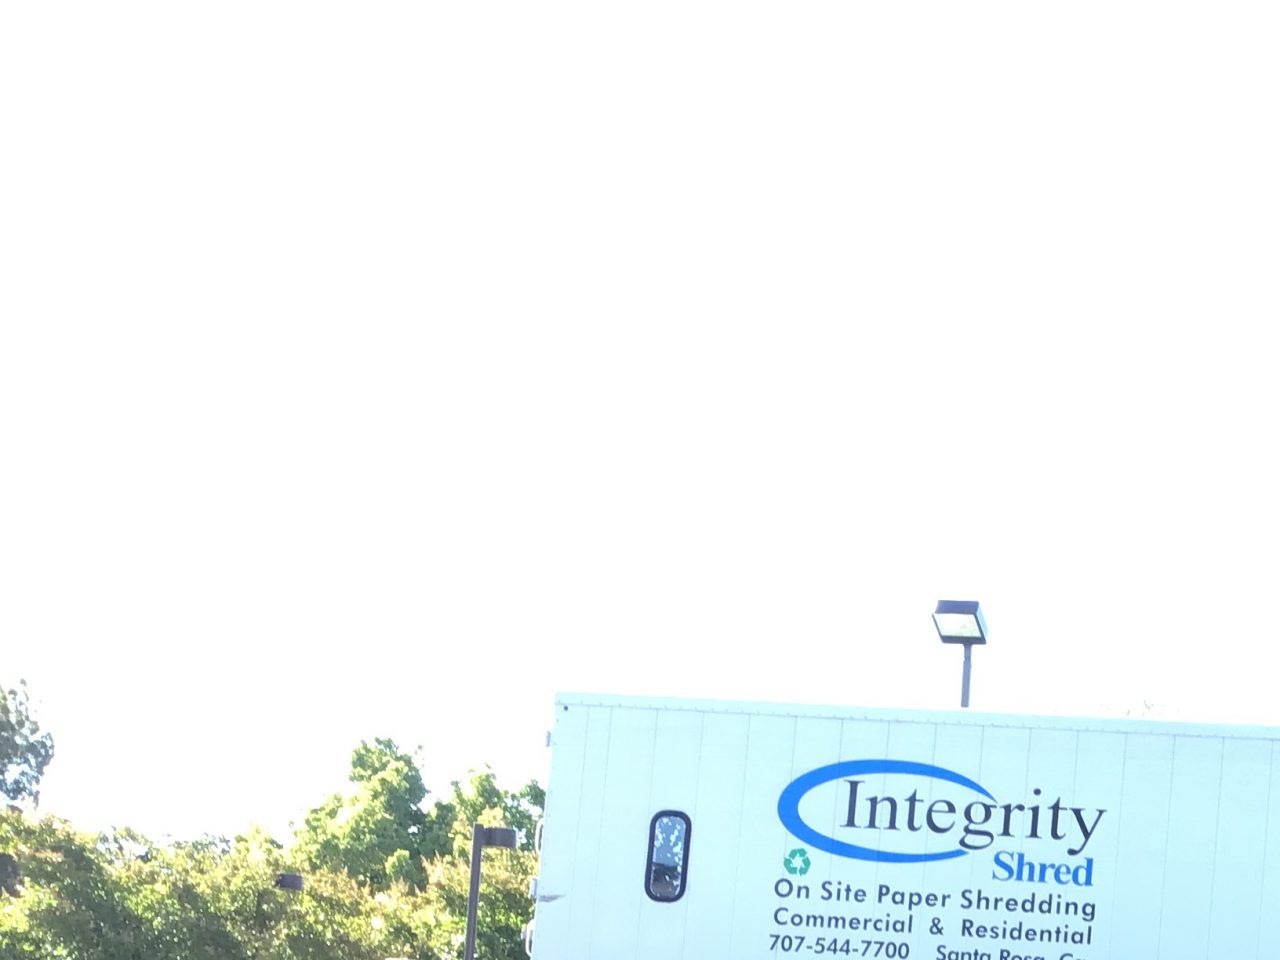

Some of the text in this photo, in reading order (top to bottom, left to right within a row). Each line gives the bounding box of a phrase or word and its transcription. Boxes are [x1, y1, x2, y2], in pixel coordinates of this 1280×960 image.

[840, 779, 1107, 856] Integrity
[992, 851, 1095, 887] Shred
[774, 879, 1096, 922] On Site Paper Shredding
[773, 907, 1093, 945] Commercial & Residential
[769, 934, 910, 960] 707-544-7700
